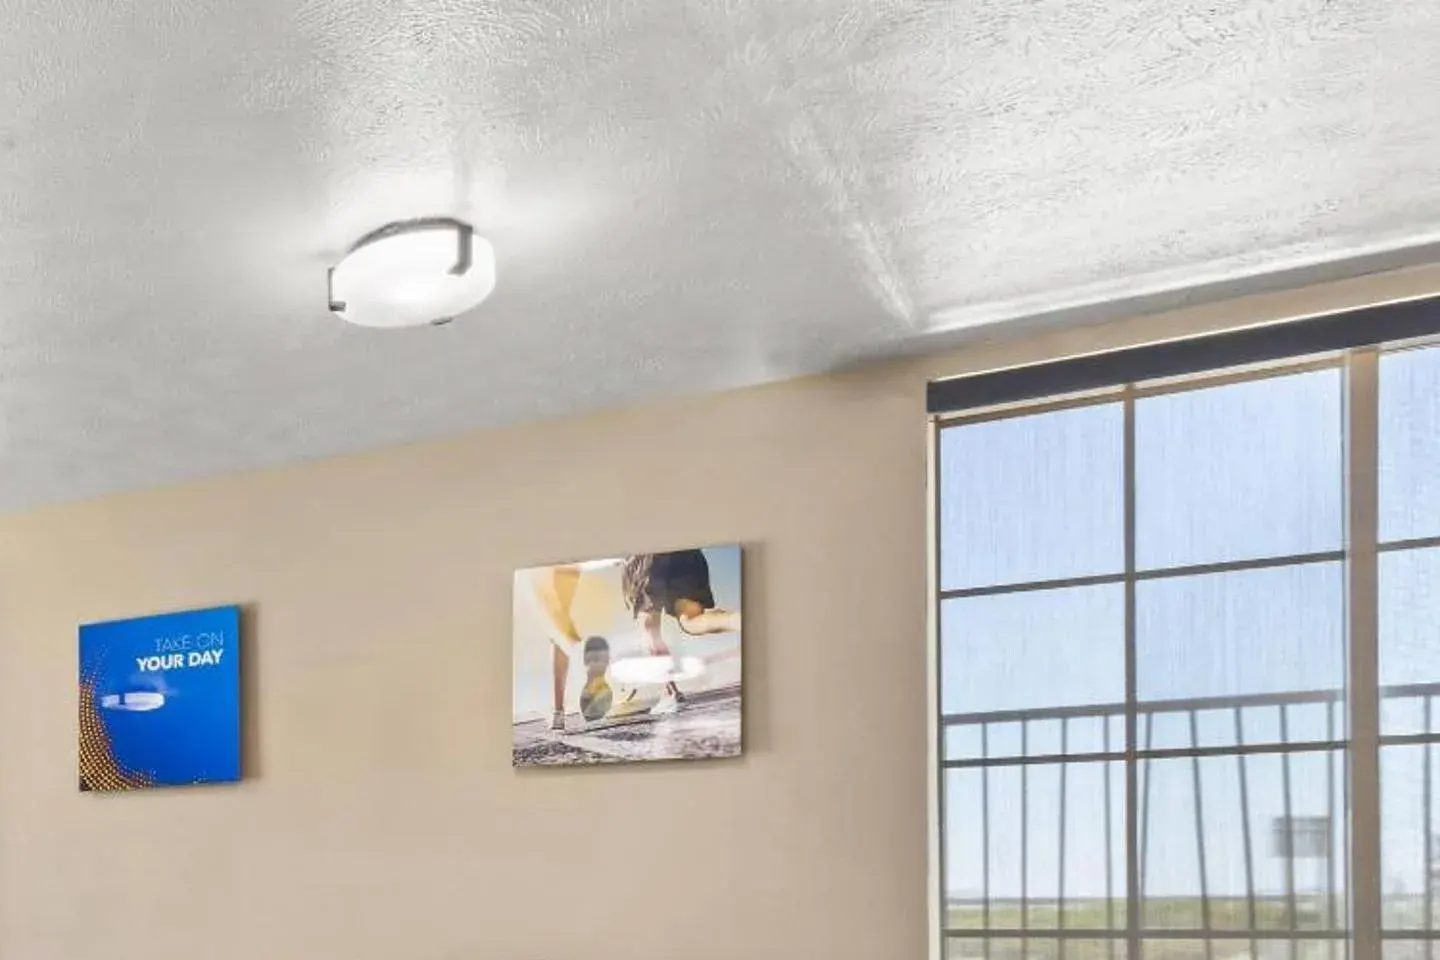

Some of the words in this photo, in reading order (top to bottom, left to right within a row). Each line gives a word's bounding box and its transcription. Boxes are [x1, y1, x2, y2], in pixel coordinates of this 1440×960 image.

[155, 634, 192, 652] TAKE
[196, 631, 224, 648] ON
[136, 653, 184, 672] YOUR
[188, 649, 224, 668] DAY
